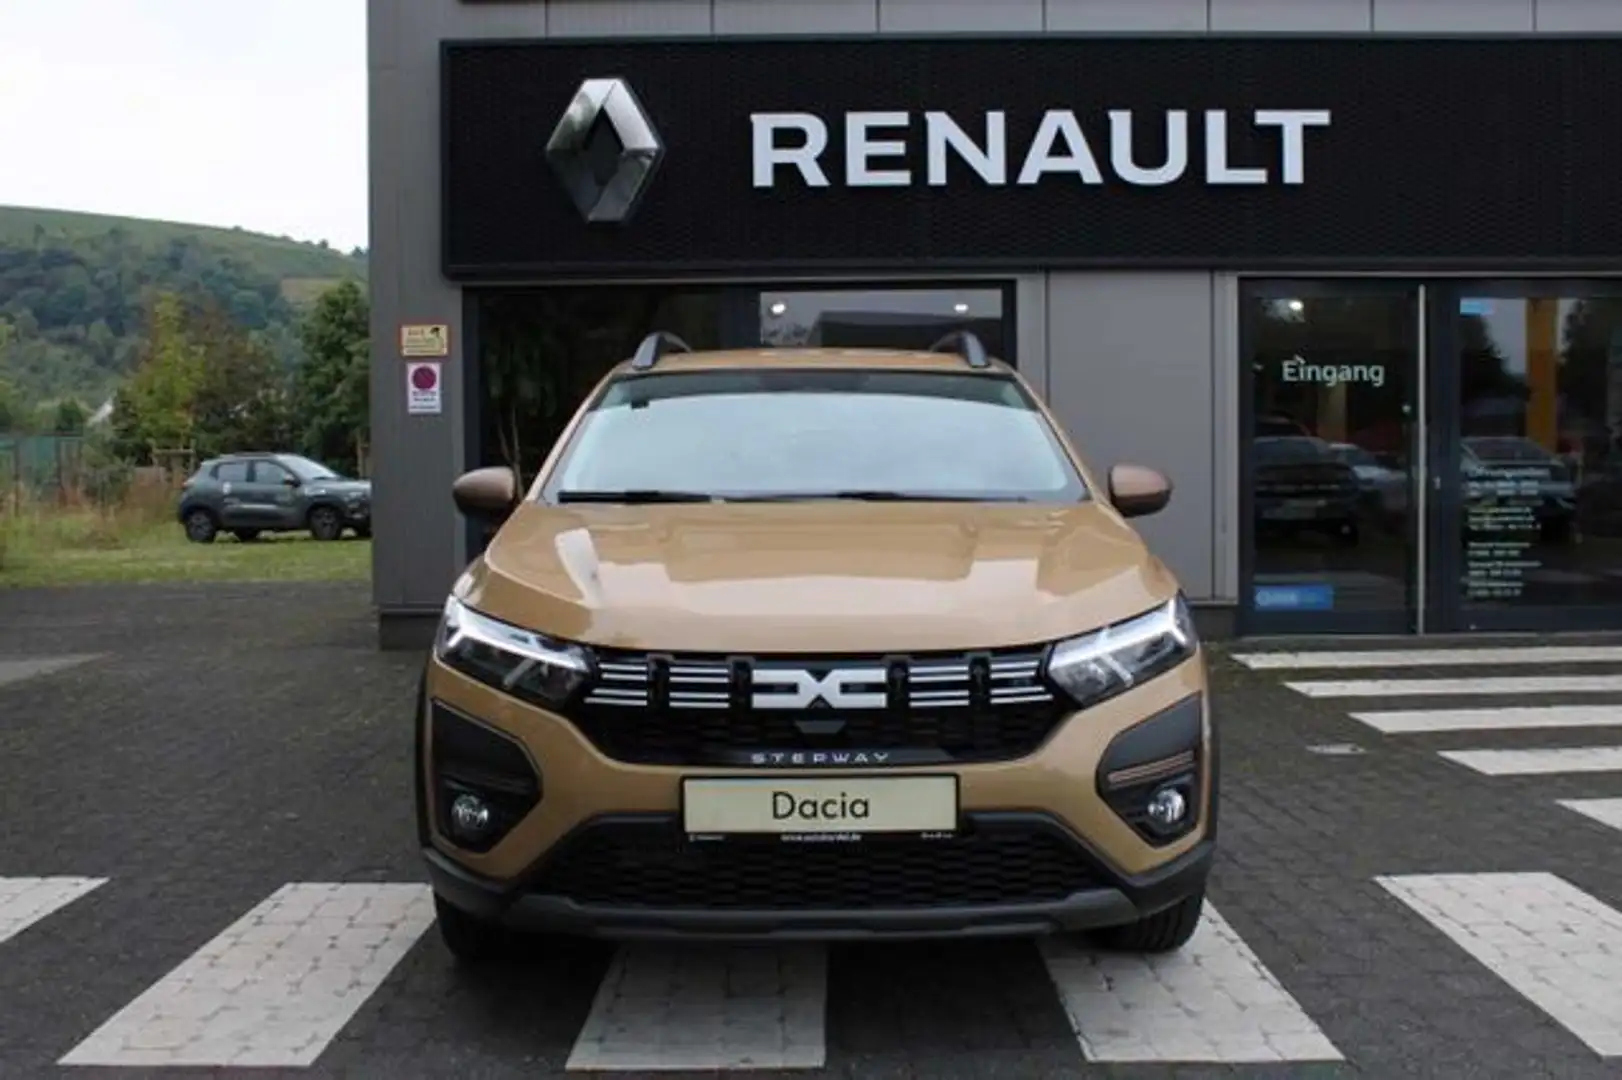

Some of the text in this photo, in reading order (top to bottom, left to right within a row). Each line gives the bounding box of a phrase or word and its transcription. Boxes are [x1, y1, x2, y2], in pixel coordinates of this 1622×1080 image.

[750, 109, 1331, 188] RENAULT
[1282, 354, 1385, 387] Eingang
[751, 752, 889, 764] STEPWAY
[772, 791, 869, 819] Dacia
